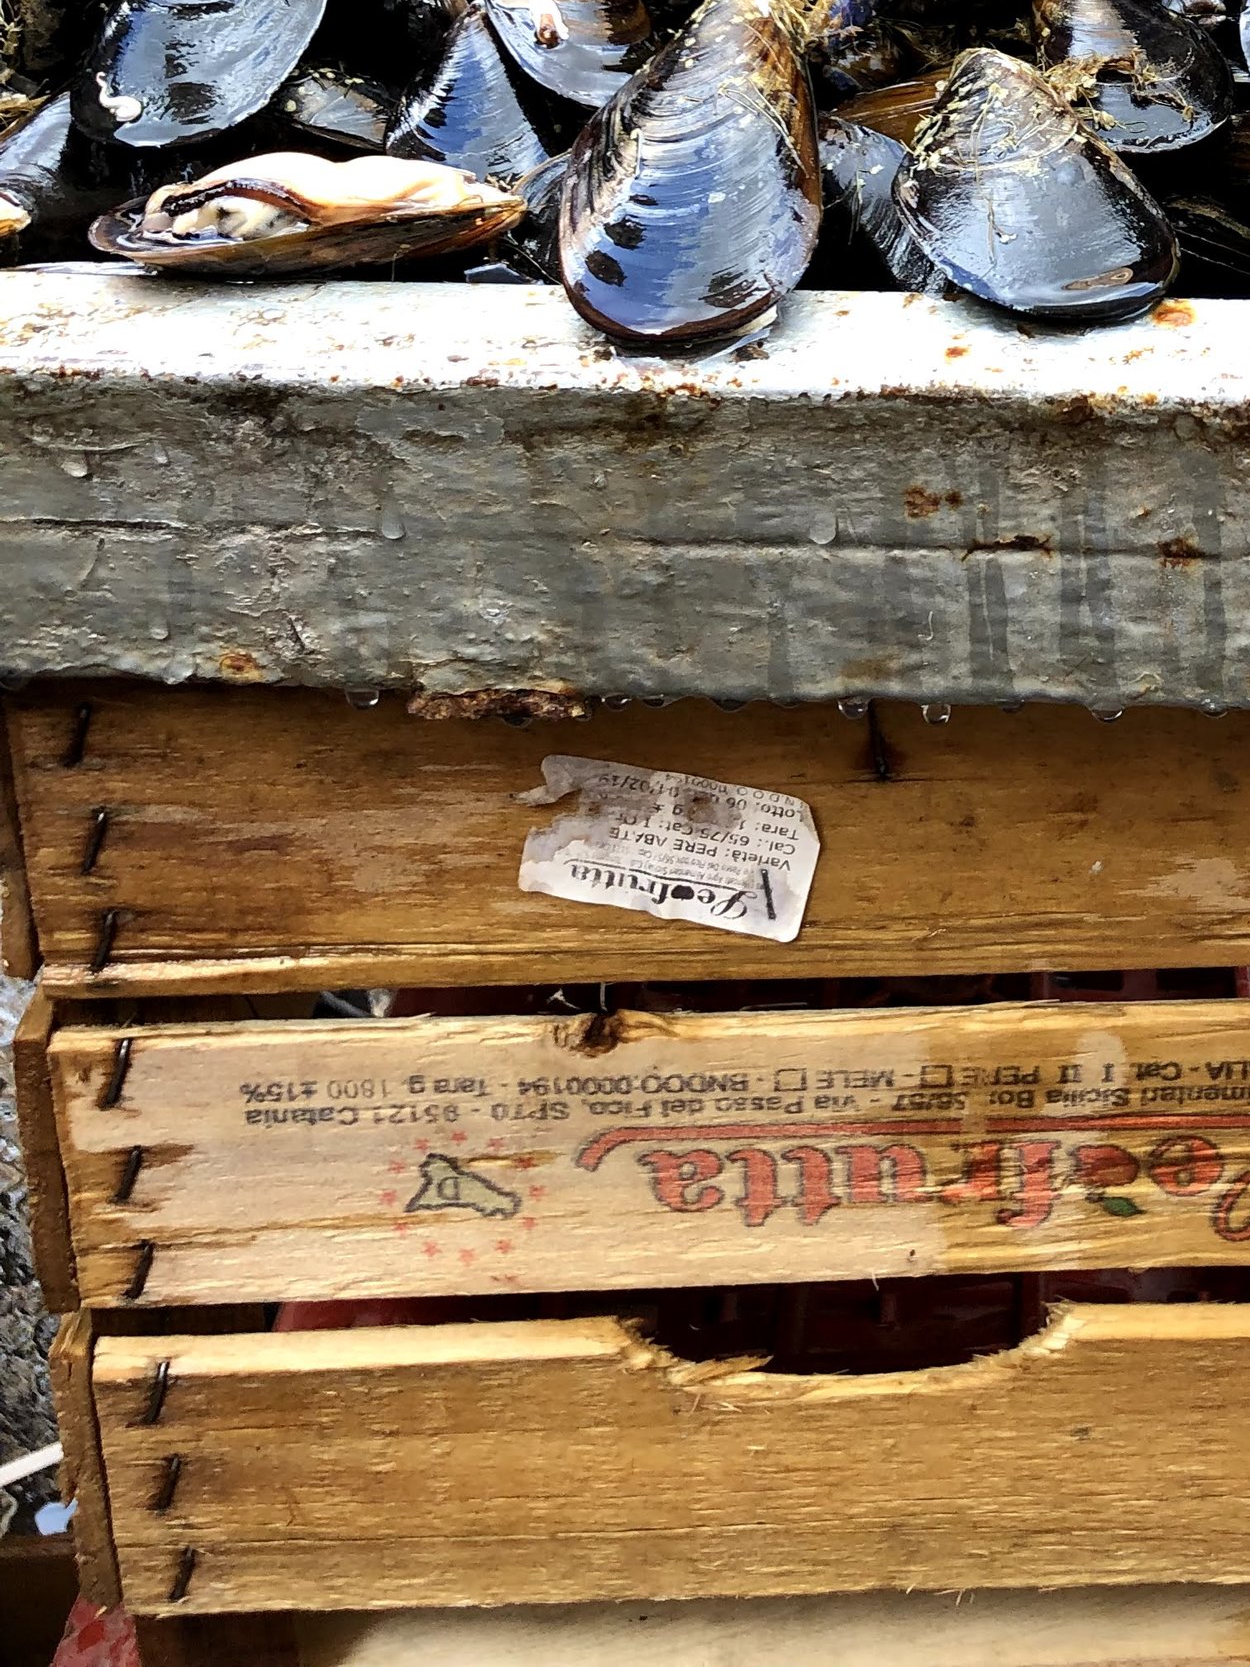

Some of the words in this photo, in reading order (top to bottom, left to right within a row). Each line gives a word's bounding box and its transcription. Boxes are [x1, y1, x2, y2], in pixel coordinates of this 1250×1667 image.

[754, 821, 800, 841] Tara:
[672, 838, 718, 857] PERE
[723, 848, 792, 872] Varietà:
[240, 1081, 320, 1105] ±15%
[328, 1078, 392, 1100] 1800
[434, 1078, 491, 1097] Tara
[1046, 1088, 1131, 1108] Sicilia
[246, 1107, 359, 1130] Catania
[436, 1176, 462, 1202] D
